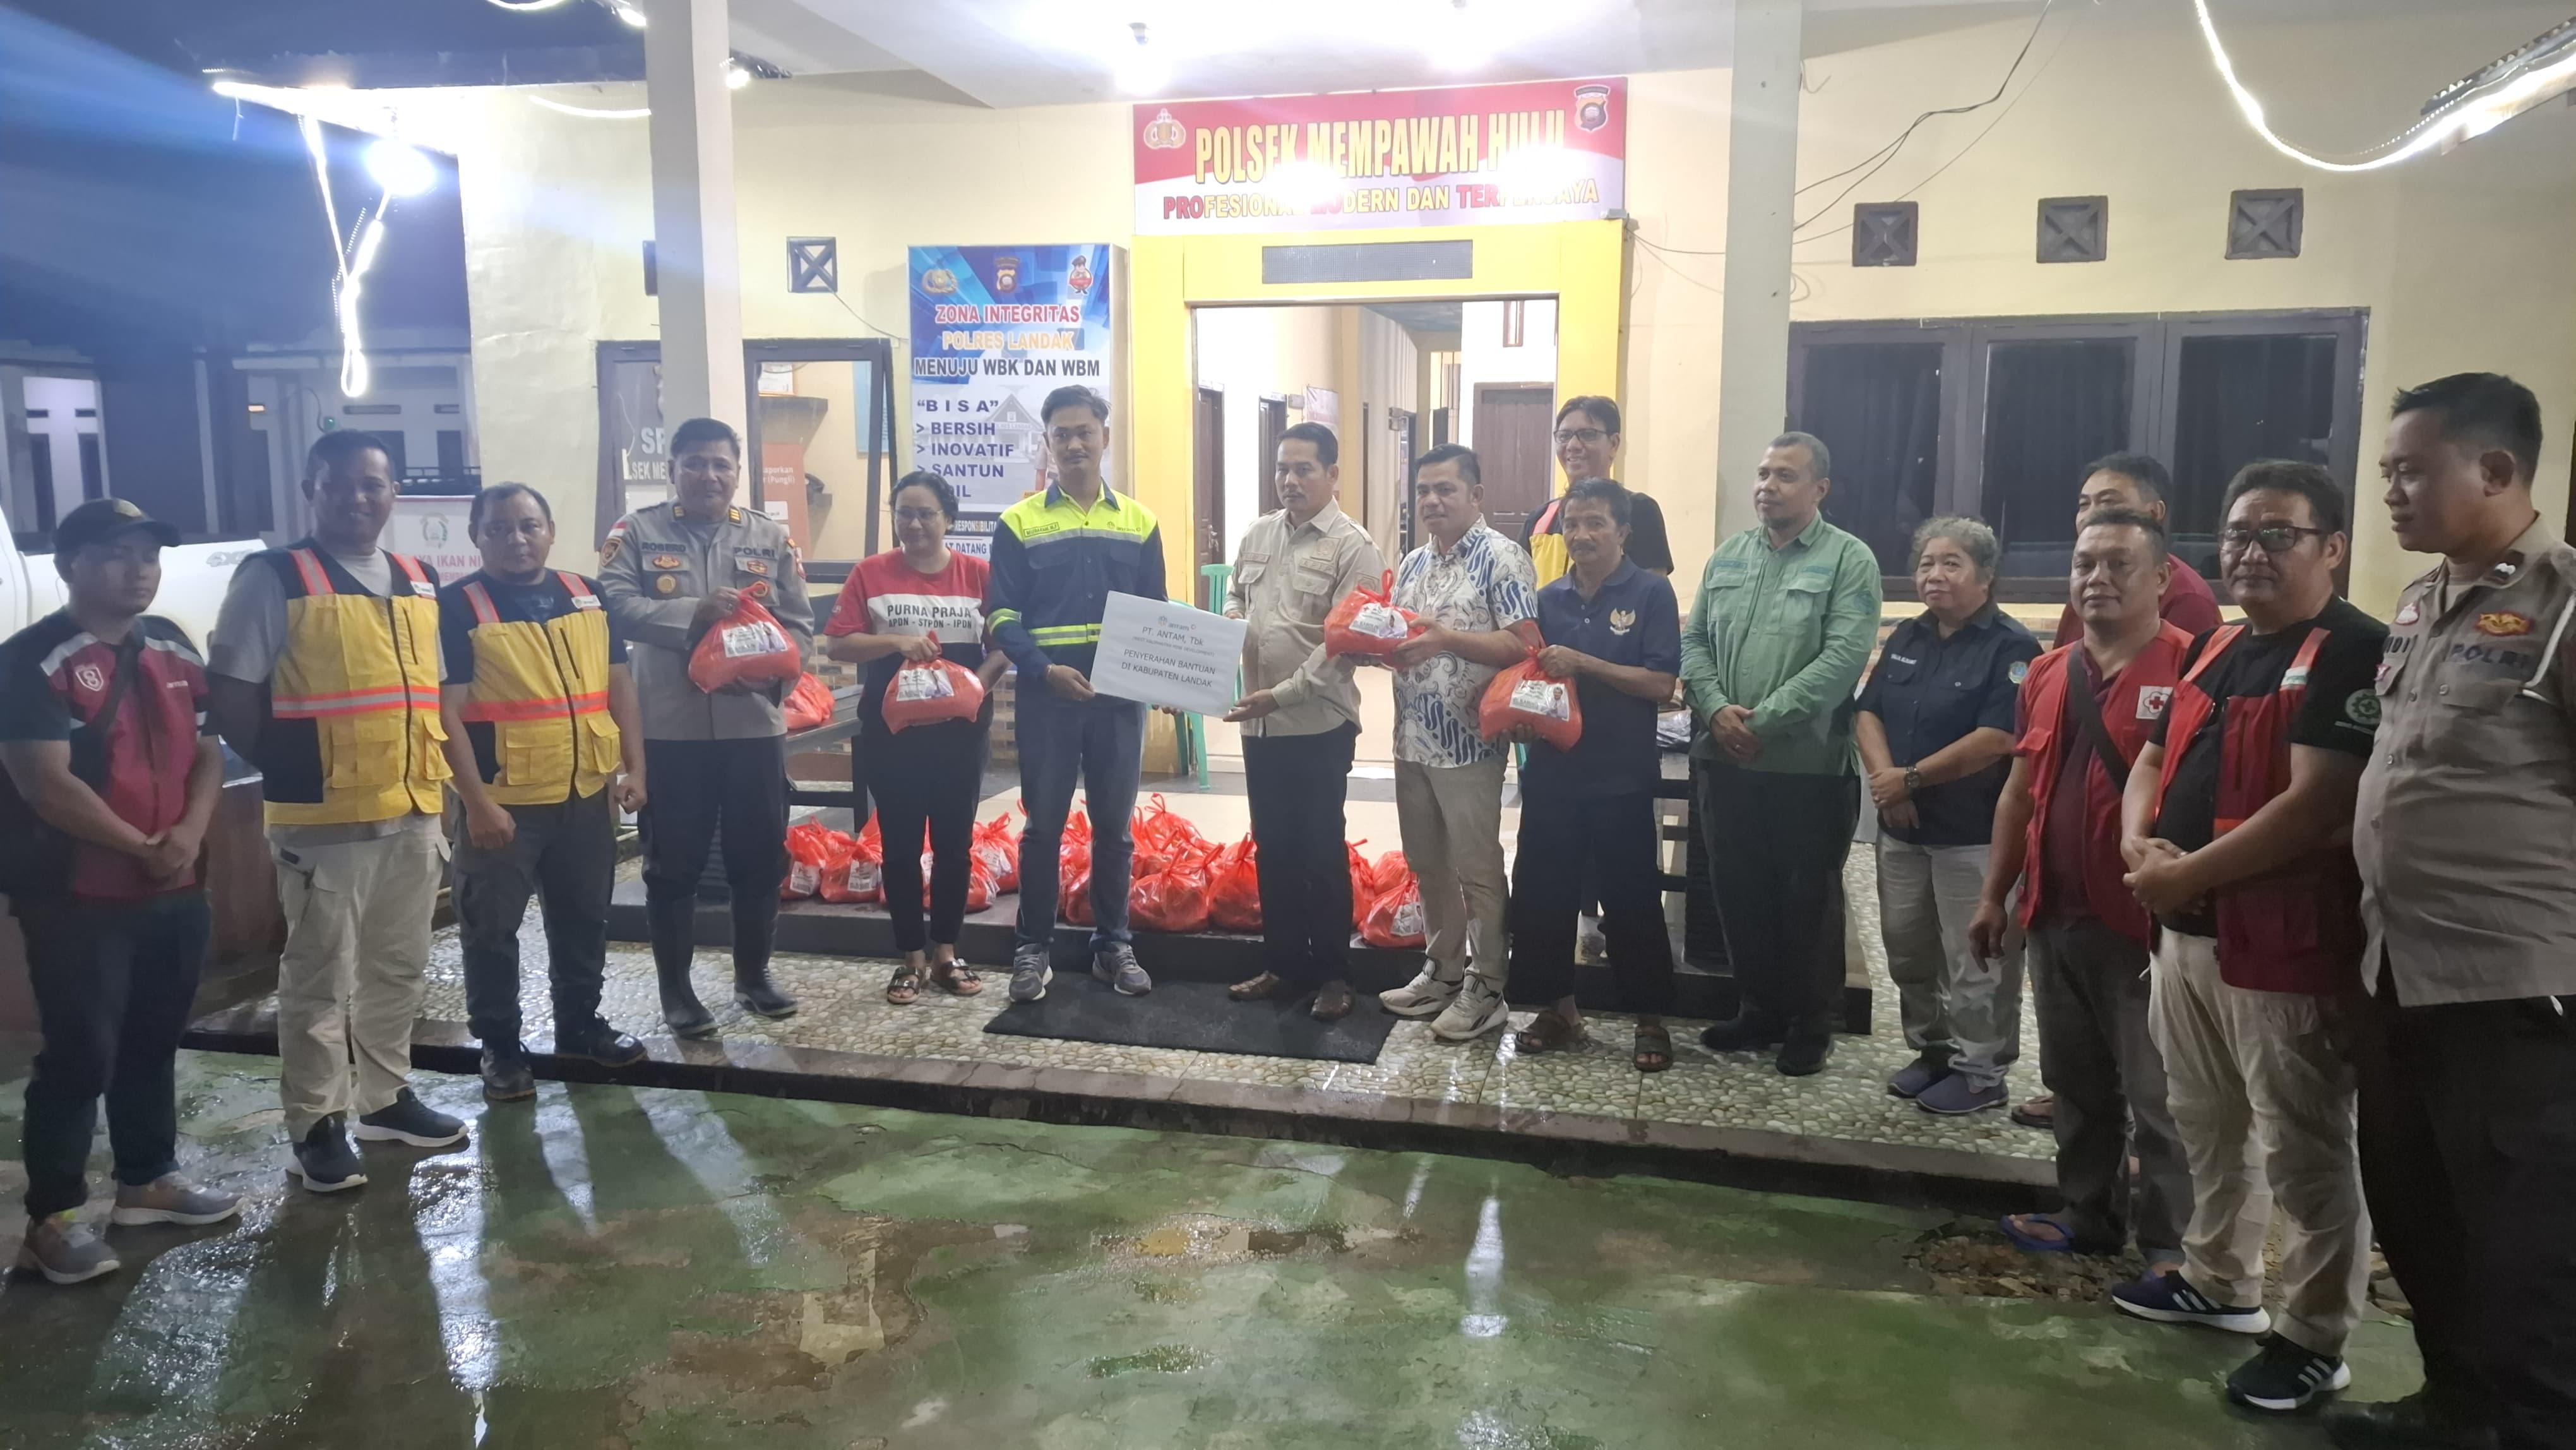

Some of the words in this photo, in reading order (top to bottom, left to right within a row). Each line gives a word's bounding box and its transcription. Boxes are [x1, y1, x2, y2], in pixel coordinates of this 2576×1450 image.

[1195, 123, 1299, 184] POLSEK
[1306, 114, 1479, 179] MEMPAWAH
[1406, 184, 1450, 212] DAN
[935, 305, 979, 323] ZONA
[984, 305, 1080, 323] INTEGRITAS
[943, 332, 1003, 349] POLRES
[1010, 332, 1075, 349] LANDAK
[914, 358, 978, 376] MENUJU
[983, 359, 1019, 376] WBK
[1024, 359, 1056, 376] DAN
[1062, 359, 1100, 376] WBM
[931, 422, 996, 435] BERSIH
[931, 443, 1014, 457] INOVATIF
[931, 463, 1004, 477] SANTUN
[733, 546, 775, 558] POLRI
[955, 542, 987, 554] DATANG
[437, 554, 465, 567] IKAN
[887, 604, 928, 617] PURNA
[932, 606, 971, 618] PRAJA
[888, 618, 909, 628] APDN
[918, 618, 944, 628] STPDN
[953, 620, 972, 629] IPDN
[1142, 626, 1154, 636] PT.
[1157, 630, 1186, 644] ANTAM,
[1190, 636, 1203, 645] Tbk
[1124, 648, 1176, 667] PENYERAHAN
[1178, 660, 1215, 675] BANTUAN
[2451, 644, 2530, 669] POLRI
[1121, 661, 1130, 670] DI
[1133, 664, 1179, 681] KABUPATEN
[1181, 674, 1213, 688] LANDAK
